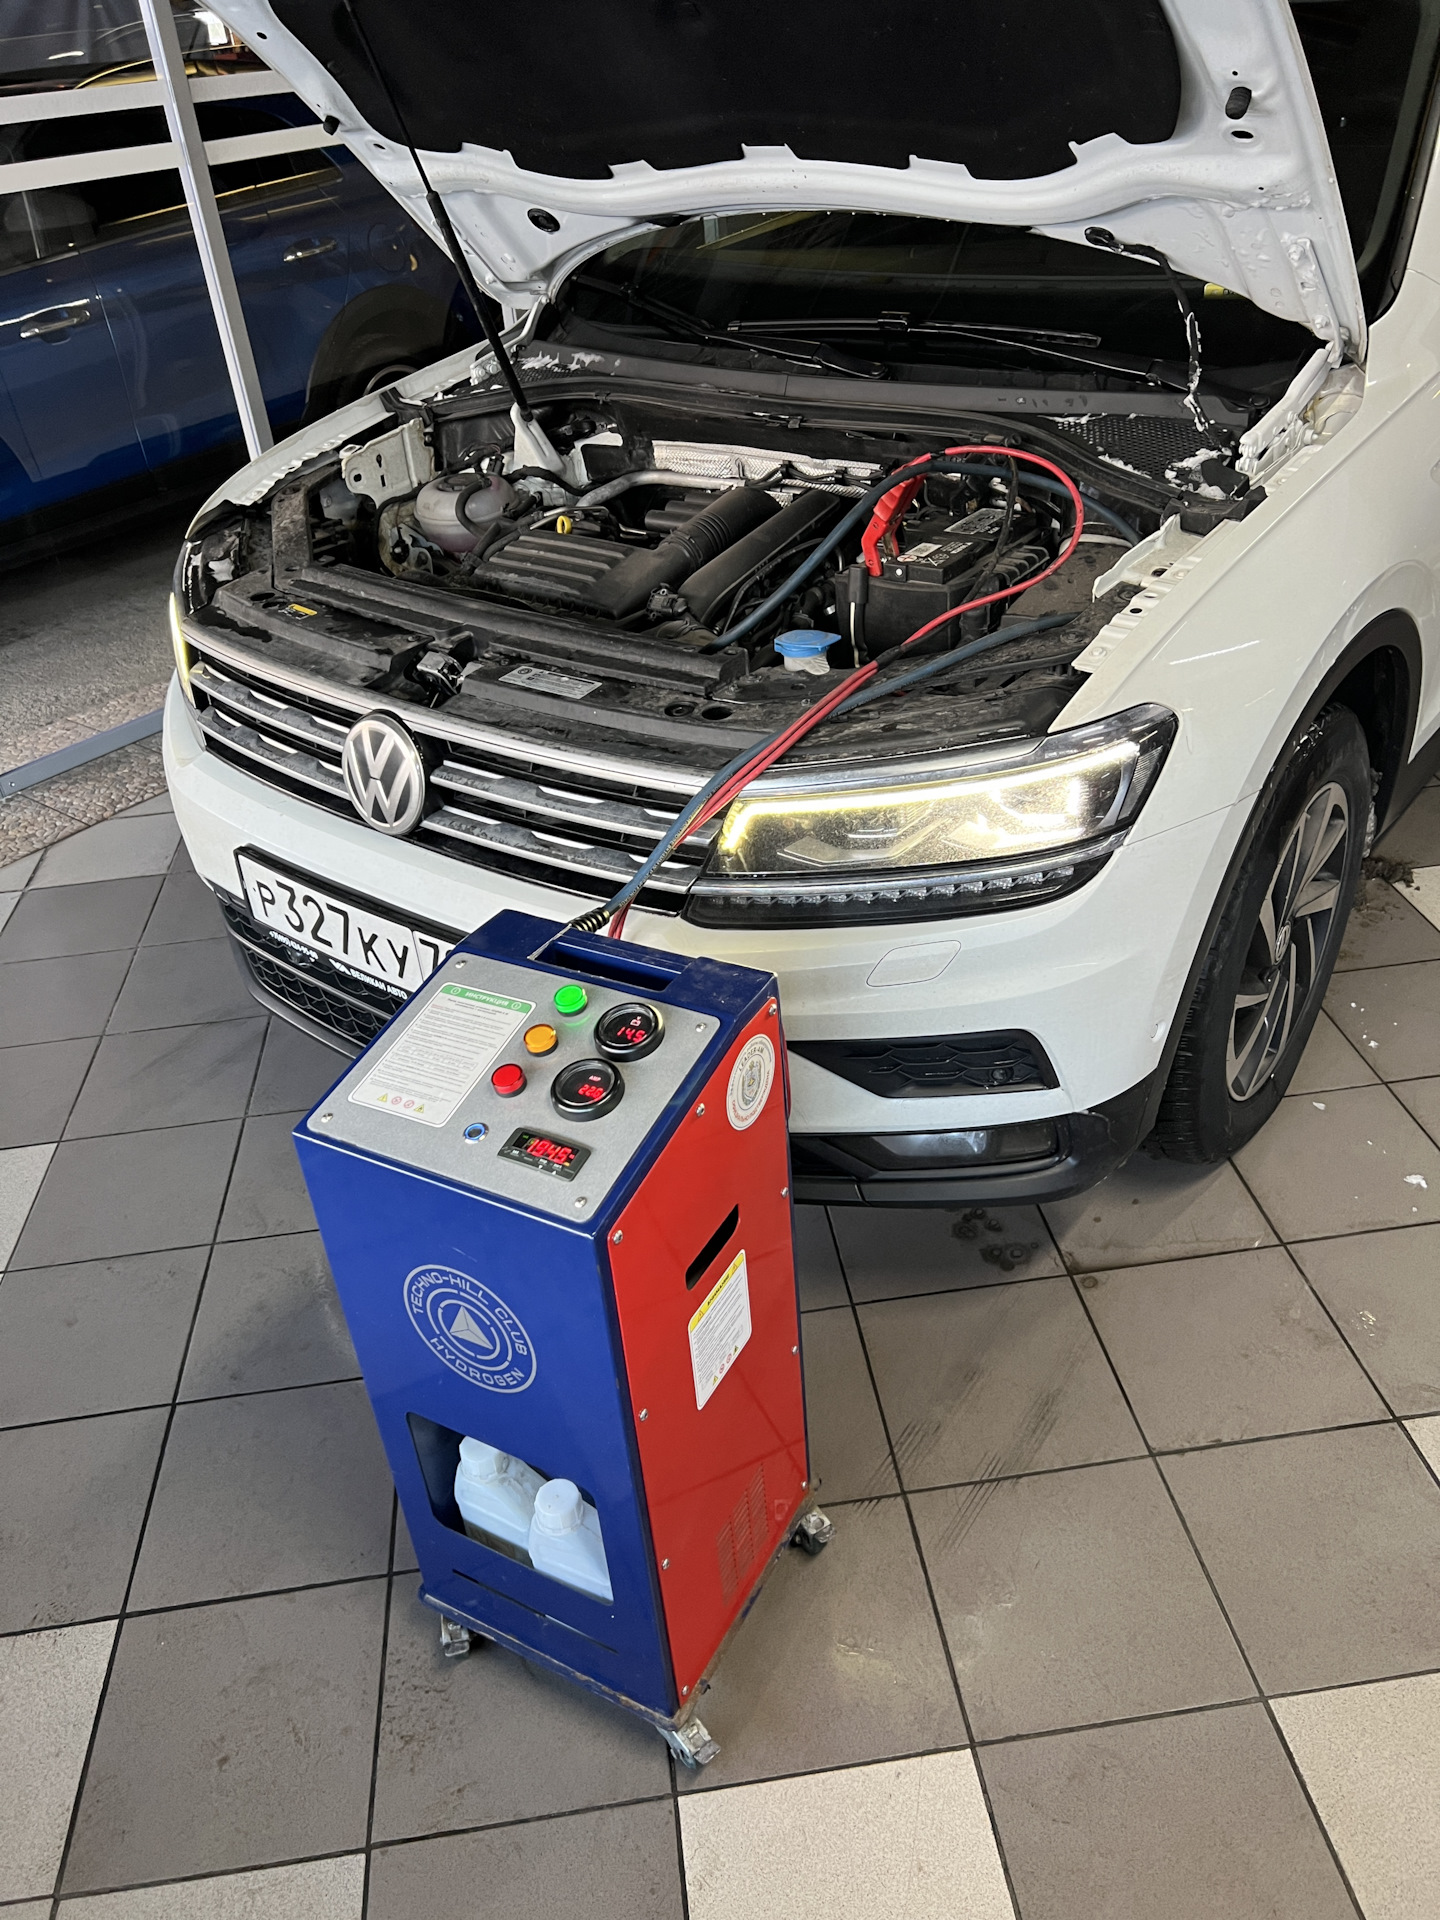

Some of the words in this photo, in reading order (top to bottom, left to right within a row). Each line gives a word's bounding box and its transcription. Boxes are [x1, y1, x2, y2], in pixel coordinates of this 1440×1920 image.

[255, 879, 409, 979] Р327КУ
[350, 969, 387, 993] ВЕЛИКАН
[386, 985, 408, 1000] АВТО
[464, 991, 510, 1007] ИНСТРУКЦИЯ
[410, 1271, 489, 1314] TECHNO-HILL
[494, 1307, 528, 1355] CLUB
[430, 1337, 525, 1387] HYDROGEN
